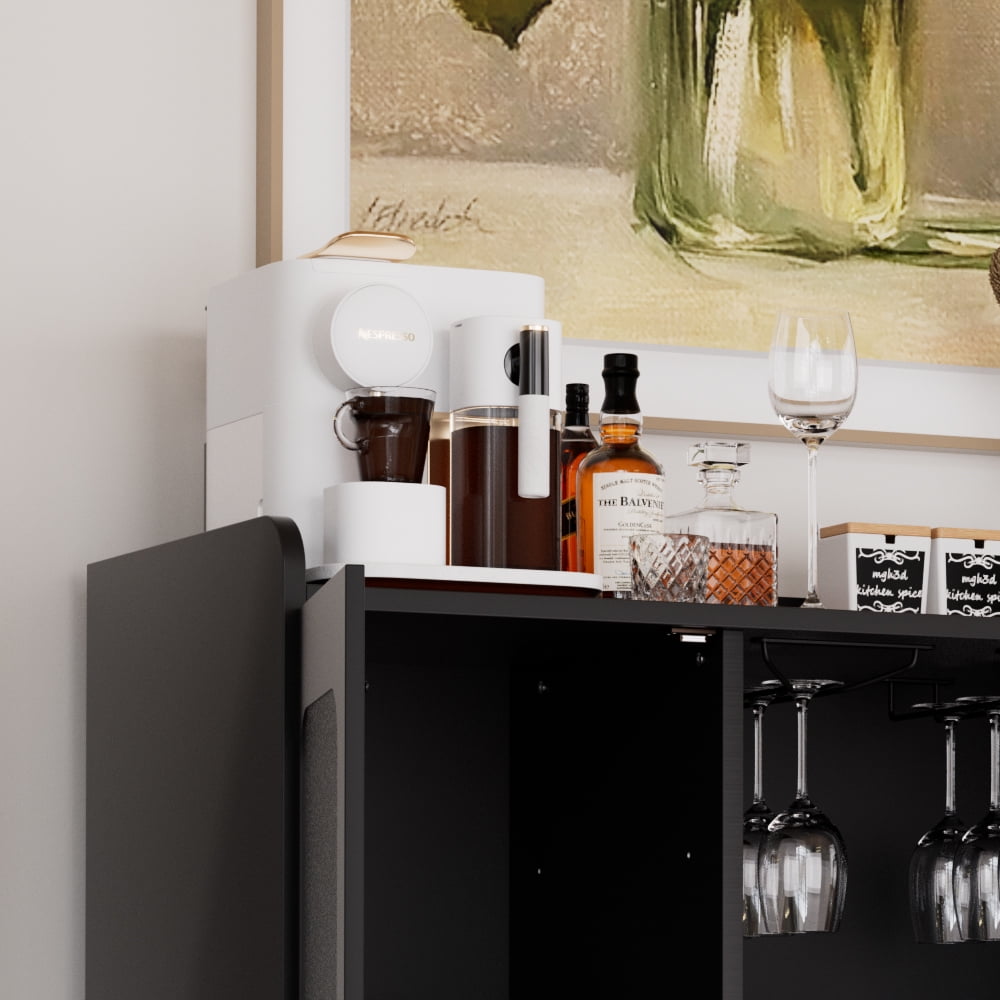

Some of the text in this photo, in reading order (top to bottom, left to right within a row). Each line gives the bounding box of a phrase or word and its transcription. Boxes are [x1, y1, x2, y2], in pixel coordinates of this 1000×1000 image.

[358, 327, 416, 342] NESPRESO
[598, 498, 618, 507] THE
[855, 583, 894, 597] kitchen
[945, 588, 984, 602] kitchen
